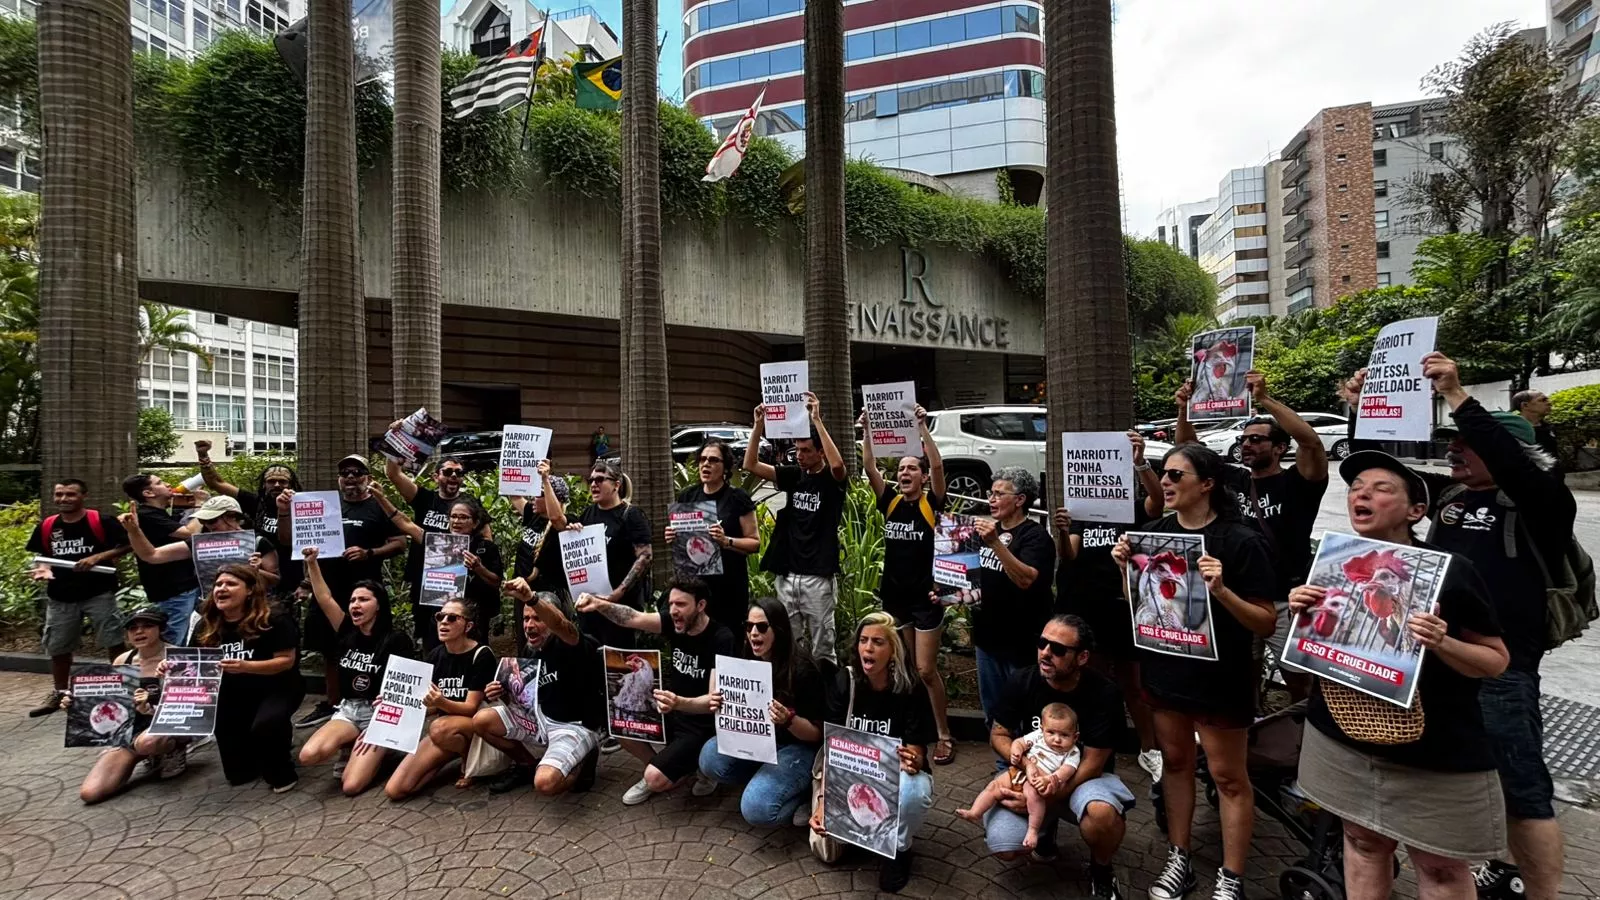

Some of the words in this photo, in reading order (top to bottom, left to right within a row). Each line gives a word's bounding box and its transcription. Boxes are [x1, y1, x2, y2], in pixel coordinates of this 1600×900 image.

[901, 246, 944, 307] R
[848, 301, 1010, 347] ENAISSANCE
[1365, 366, 1382, 380] COM
[1384, 363, 1410, 378] ESSA
[763, 374, 798, 385] MARRIOTT
[1364, 378, 1422, 394] CRUELDADE
[764, 385, 784, 394] APOIA
[785, 384, 790, 393] A
[764, 393, 804, 404] CRUELDADE
[866, 391, 904, 402] MARRIOTT
[1361, 398, 1375, 407] PELO
[1375, 397, 1387, 406] FIM
[867, 402, 886, 411] PARE
[1360, 409, 1371, 417] DAS
[1371, 407, 1400, 417] GAIOLAS!
[869, 412, 885, 421] COM
[885, 411, 906, 420] ESSA
[870, 420, 914, 430] CRUELDADE
[505, 433, 541, 442] MARRIOTT
[504, 441, 521, 449] PARE
[503, 450, 517, 458] COM
[517, 450, 535, 459] ESSA
[1067, 449, 1123, 461] MARRIOTT,
[1067, 462, 1102, 473] PONHA
[1067, 474, 1085, 485] FIM
[1087, 475, 1122, 486] NESSA
[1068, 486, 1129, 499] CRUELDADE
[422, 518, 450, 530] EQUALI
[1082, 525, 1116, 538] anim
[562, 536, 595, 551] MARRIOTT
[1083, 536, 1120, 548] EQUAL
[564, 550, 583, 561] APOIA
[584, 548, 589, 556] A
[565, 553, 603, 570] CRUELDADE
[1140, 625, 1154, 636] ISSO
[1155, 627, 1160, 637] É
[1160, 629, 1204, 644] CRUELDADE
[220, 639, 244, 653] mal
[223, 648, 255, 661] ALITY
[1302, 641, 1326, 657] ISSO
[1326, 649, 1335, 660] É
[1336, 652, 1399, 682] CRUELDADE
[386, 669, 423, 686] MARRIOTT
[719, 674, 764, 694] MARRIOTT,
[384, 681, 405, 694] APOIA
[407, 686, 413, 696] A
[383, 691, 423, 710] CRUELDADE
[735, 705, 765, 721] NESSA
[719, 716, 772, 736] CRUELDADE
[843, 754, 857, 762] ovos
[857, 758, 870, 766] vêm
[830, 759, 852, 769] sistema
[860, 767, 885, 779] gaiolas?
